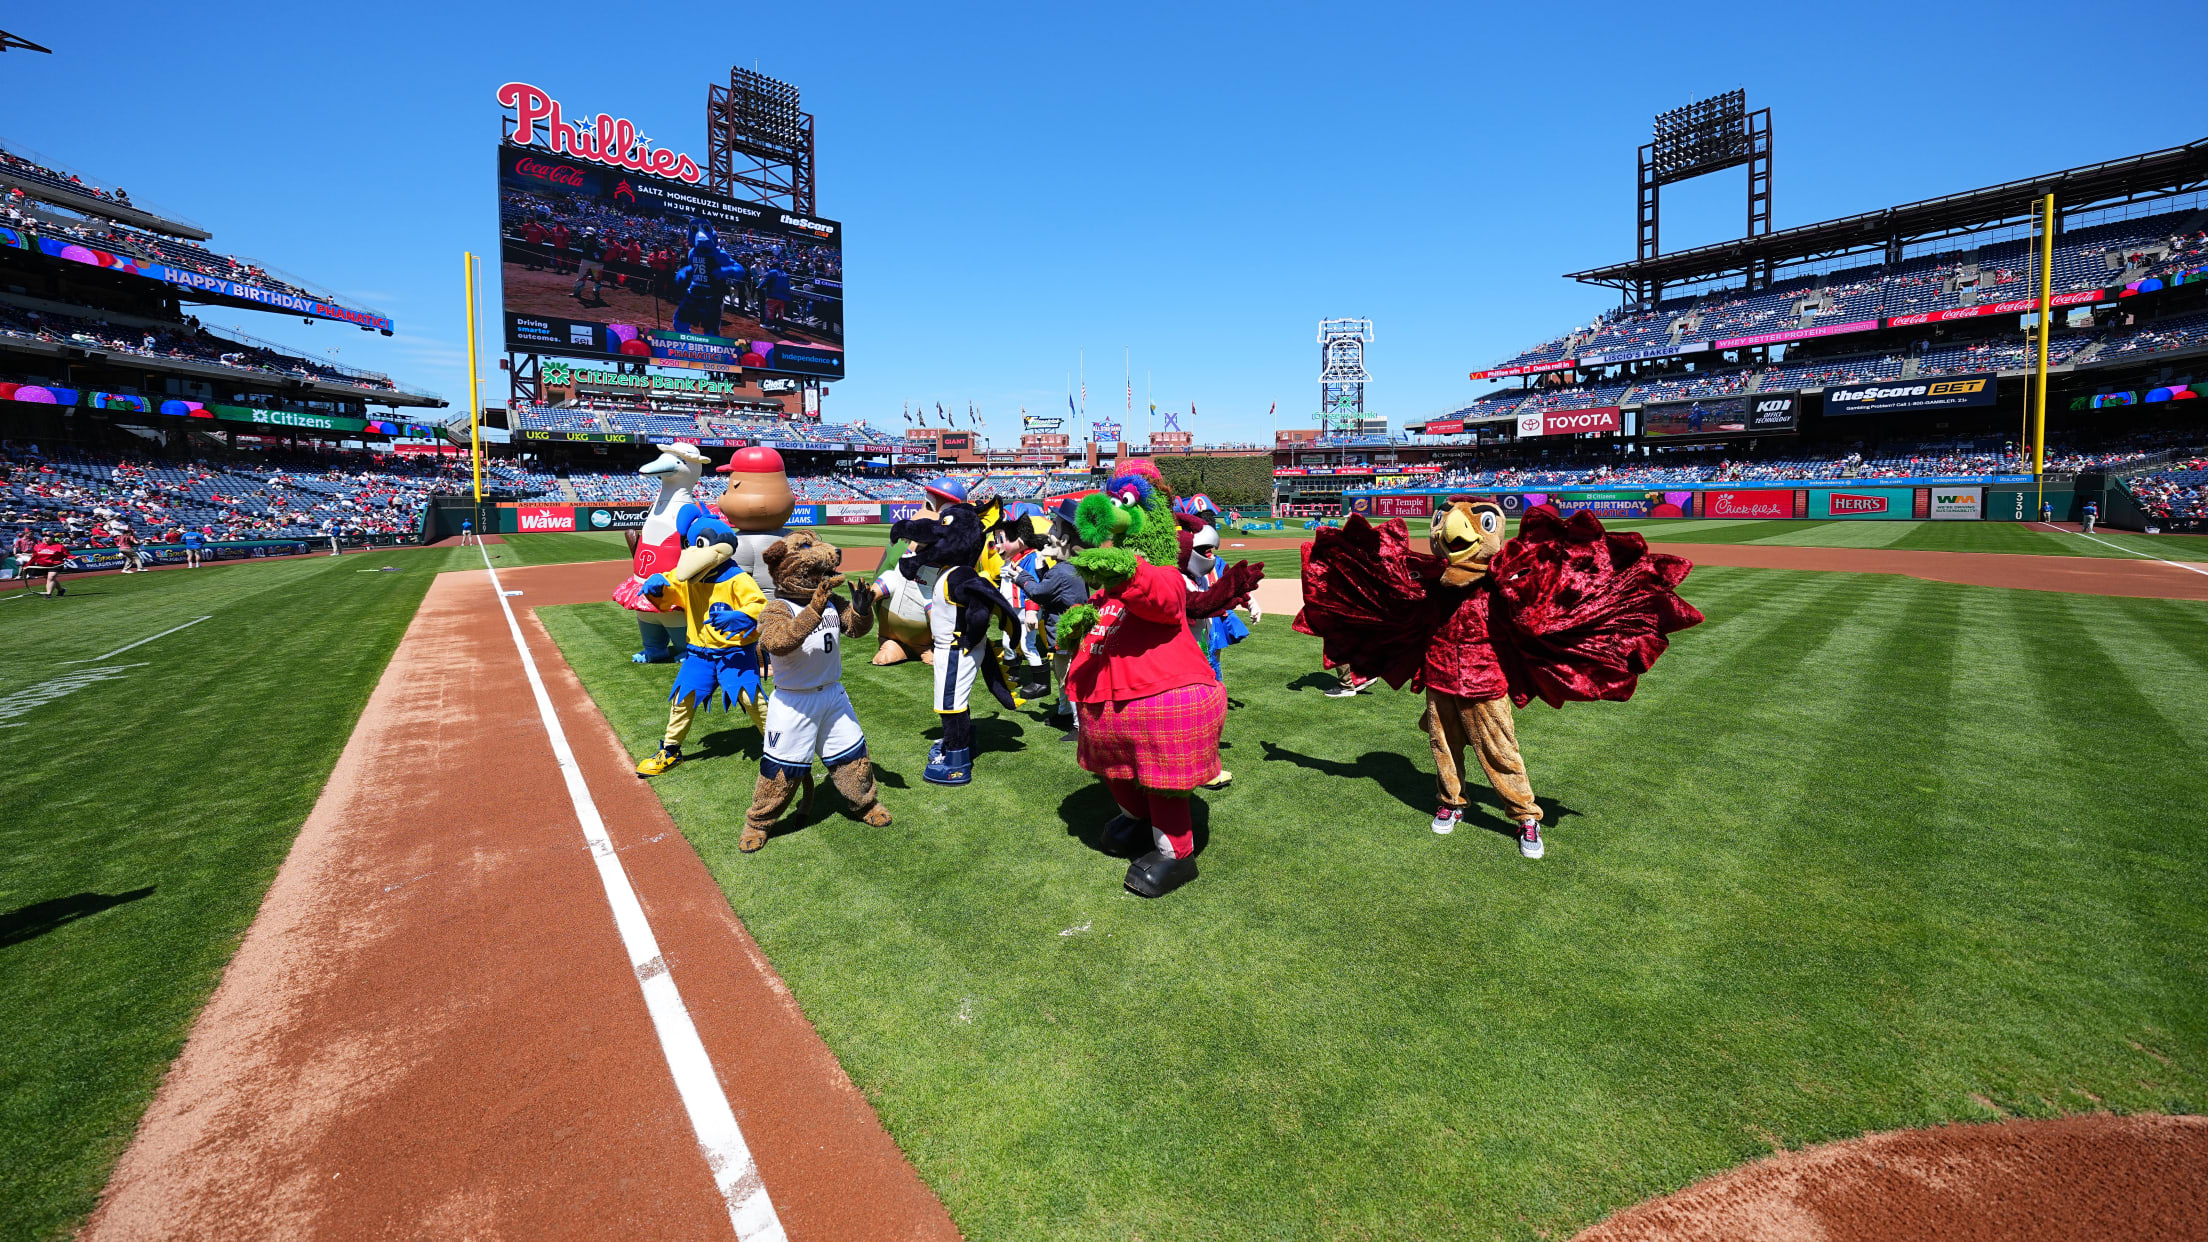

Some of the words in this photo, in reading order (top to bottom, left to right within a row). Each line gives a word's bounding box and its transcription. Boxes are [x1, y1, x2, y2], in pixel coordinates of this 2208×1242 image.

[497, 82, 701, 184] Phillies
[515, 157, 586, 187] Coca-Cola
[638, 185, 664, 197] SALTZ
[667, 191, 720, 209] MONGELUZZI
[722, 203, 762, 218] BENDESKY
[663, 201, 696, 213] INJURY
[702, 209, 740, 222] LAWYERS
[780, 214, 834, 233] theScore
[693, 263, 706, 274] 76
[164, 267, 228, 293] HAPPY
[233, 284, 313, 313] BIRTHDAY
[2050, 291, 2097, 306] Coca-Cola
[1993, 300, 2035, 313] Coca-Cola
[1893, 313, 1930, 326] Coca-Cola
[1941, 307, 1981, 320] Coca-Cola
[517, 318, 548, 329] Driving
[517, 326, 550, 335] smarter
[517, 333, 561, 343] outcomes.
[1719, 338, 1745, 348] WHEY
[1748, 334, 1782, 344] BETTER
[1784, 328, 1827, 338] PROTEIN
[651, 338, 686, 350] HAPPY
[688, 342, 736, 355] BIRTHDAY
[782, 352, 831, 365] Independence
[1604, 352, 1641, 363] LISCIO'S
[1643, 346, 1680, 358] BAKERY
[1487, 369, 1508, 378] Phillies
[1533, 363, 1551, 372] Deals
[574, 367, 649, 388] Citizens
[653, 374, 696, 392] Bank
[699, 378, 735, 395] Park
[1831, 385, 1927, 402] theScore
[1933, 380, 1982, 394] BET
[1755, 399, 1792, 413] KDI
[271, 411, 332, 429] Citizens
[1313, 411, 1351, 420] Citizens
[1547, 413, 1613, 430] TOYOTA
[1755, 415, 1792, 424] TECHNOLOGY
[1763, 411, 1783, 419] OFFICE
[526, 431, 549, 440] UKG
[566, 433, 589, 441] UKG
[605, 434, 626, 443] UKG
[775, 441, 804, 449] LISCIO'S
[1395, 498, 1423, 507] Temple
[1559, 501, 1591, 509] HAPPY
[1594, 500, 1646, 509] BIRTHDAY
[1834, 497, 1881, 510] HERR'S
[1937, 495, 1976, 504] WM
[2015, 492, 2023, 520] 330
[1396, 506, 1422, 515] Health
[1575, 509, 1629, 517] PNATIC!
[1714, 498, 1781, 516] Chick-fil-A
[521, 515, 572, 529] Wawa
[843, 515, 866, 523] LAGER
[639, 549, 656, 576] P
[823, 632, 833, 654] 6
[767, 730, 781, 749] V
